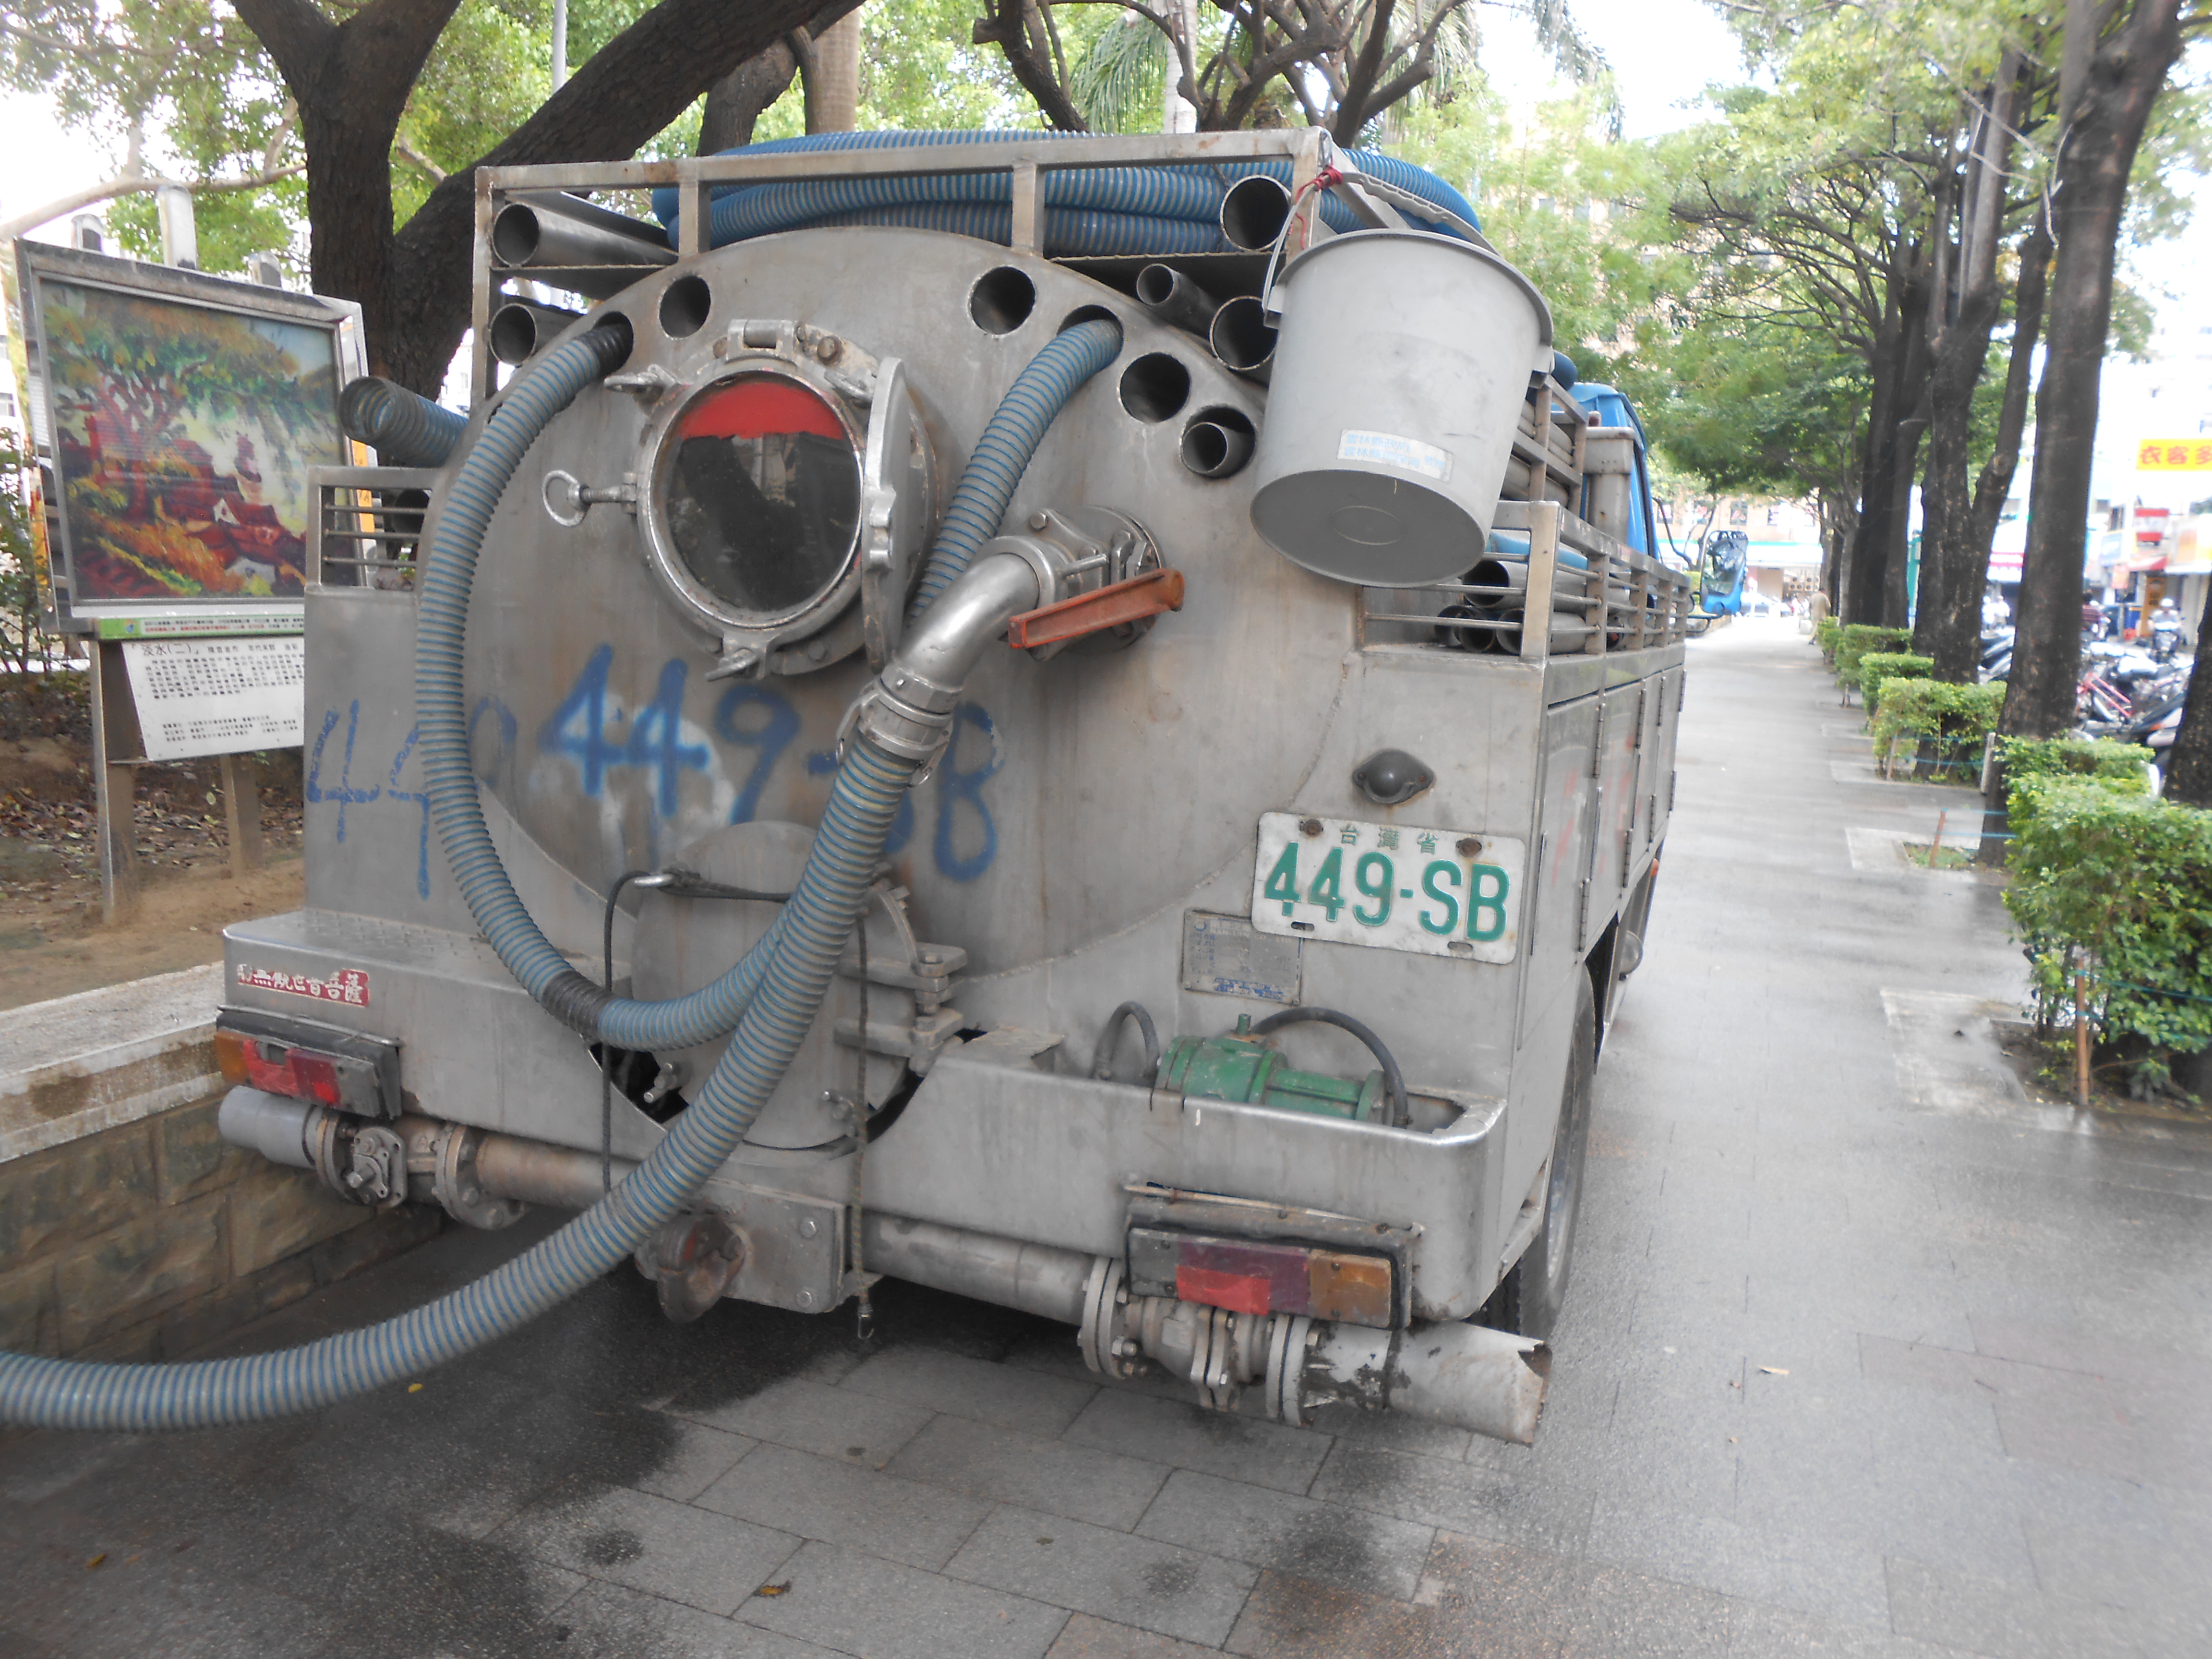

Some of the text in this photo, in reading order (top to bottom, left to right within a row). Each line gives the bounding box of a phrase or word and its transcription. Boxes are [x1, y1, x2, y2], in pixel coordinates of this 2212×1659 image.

[536, 642, 1004, 883] 449-B
[1340, 823, 1439, 854] 台灣省
[1264, 841, 1510, 942] 449-SB
